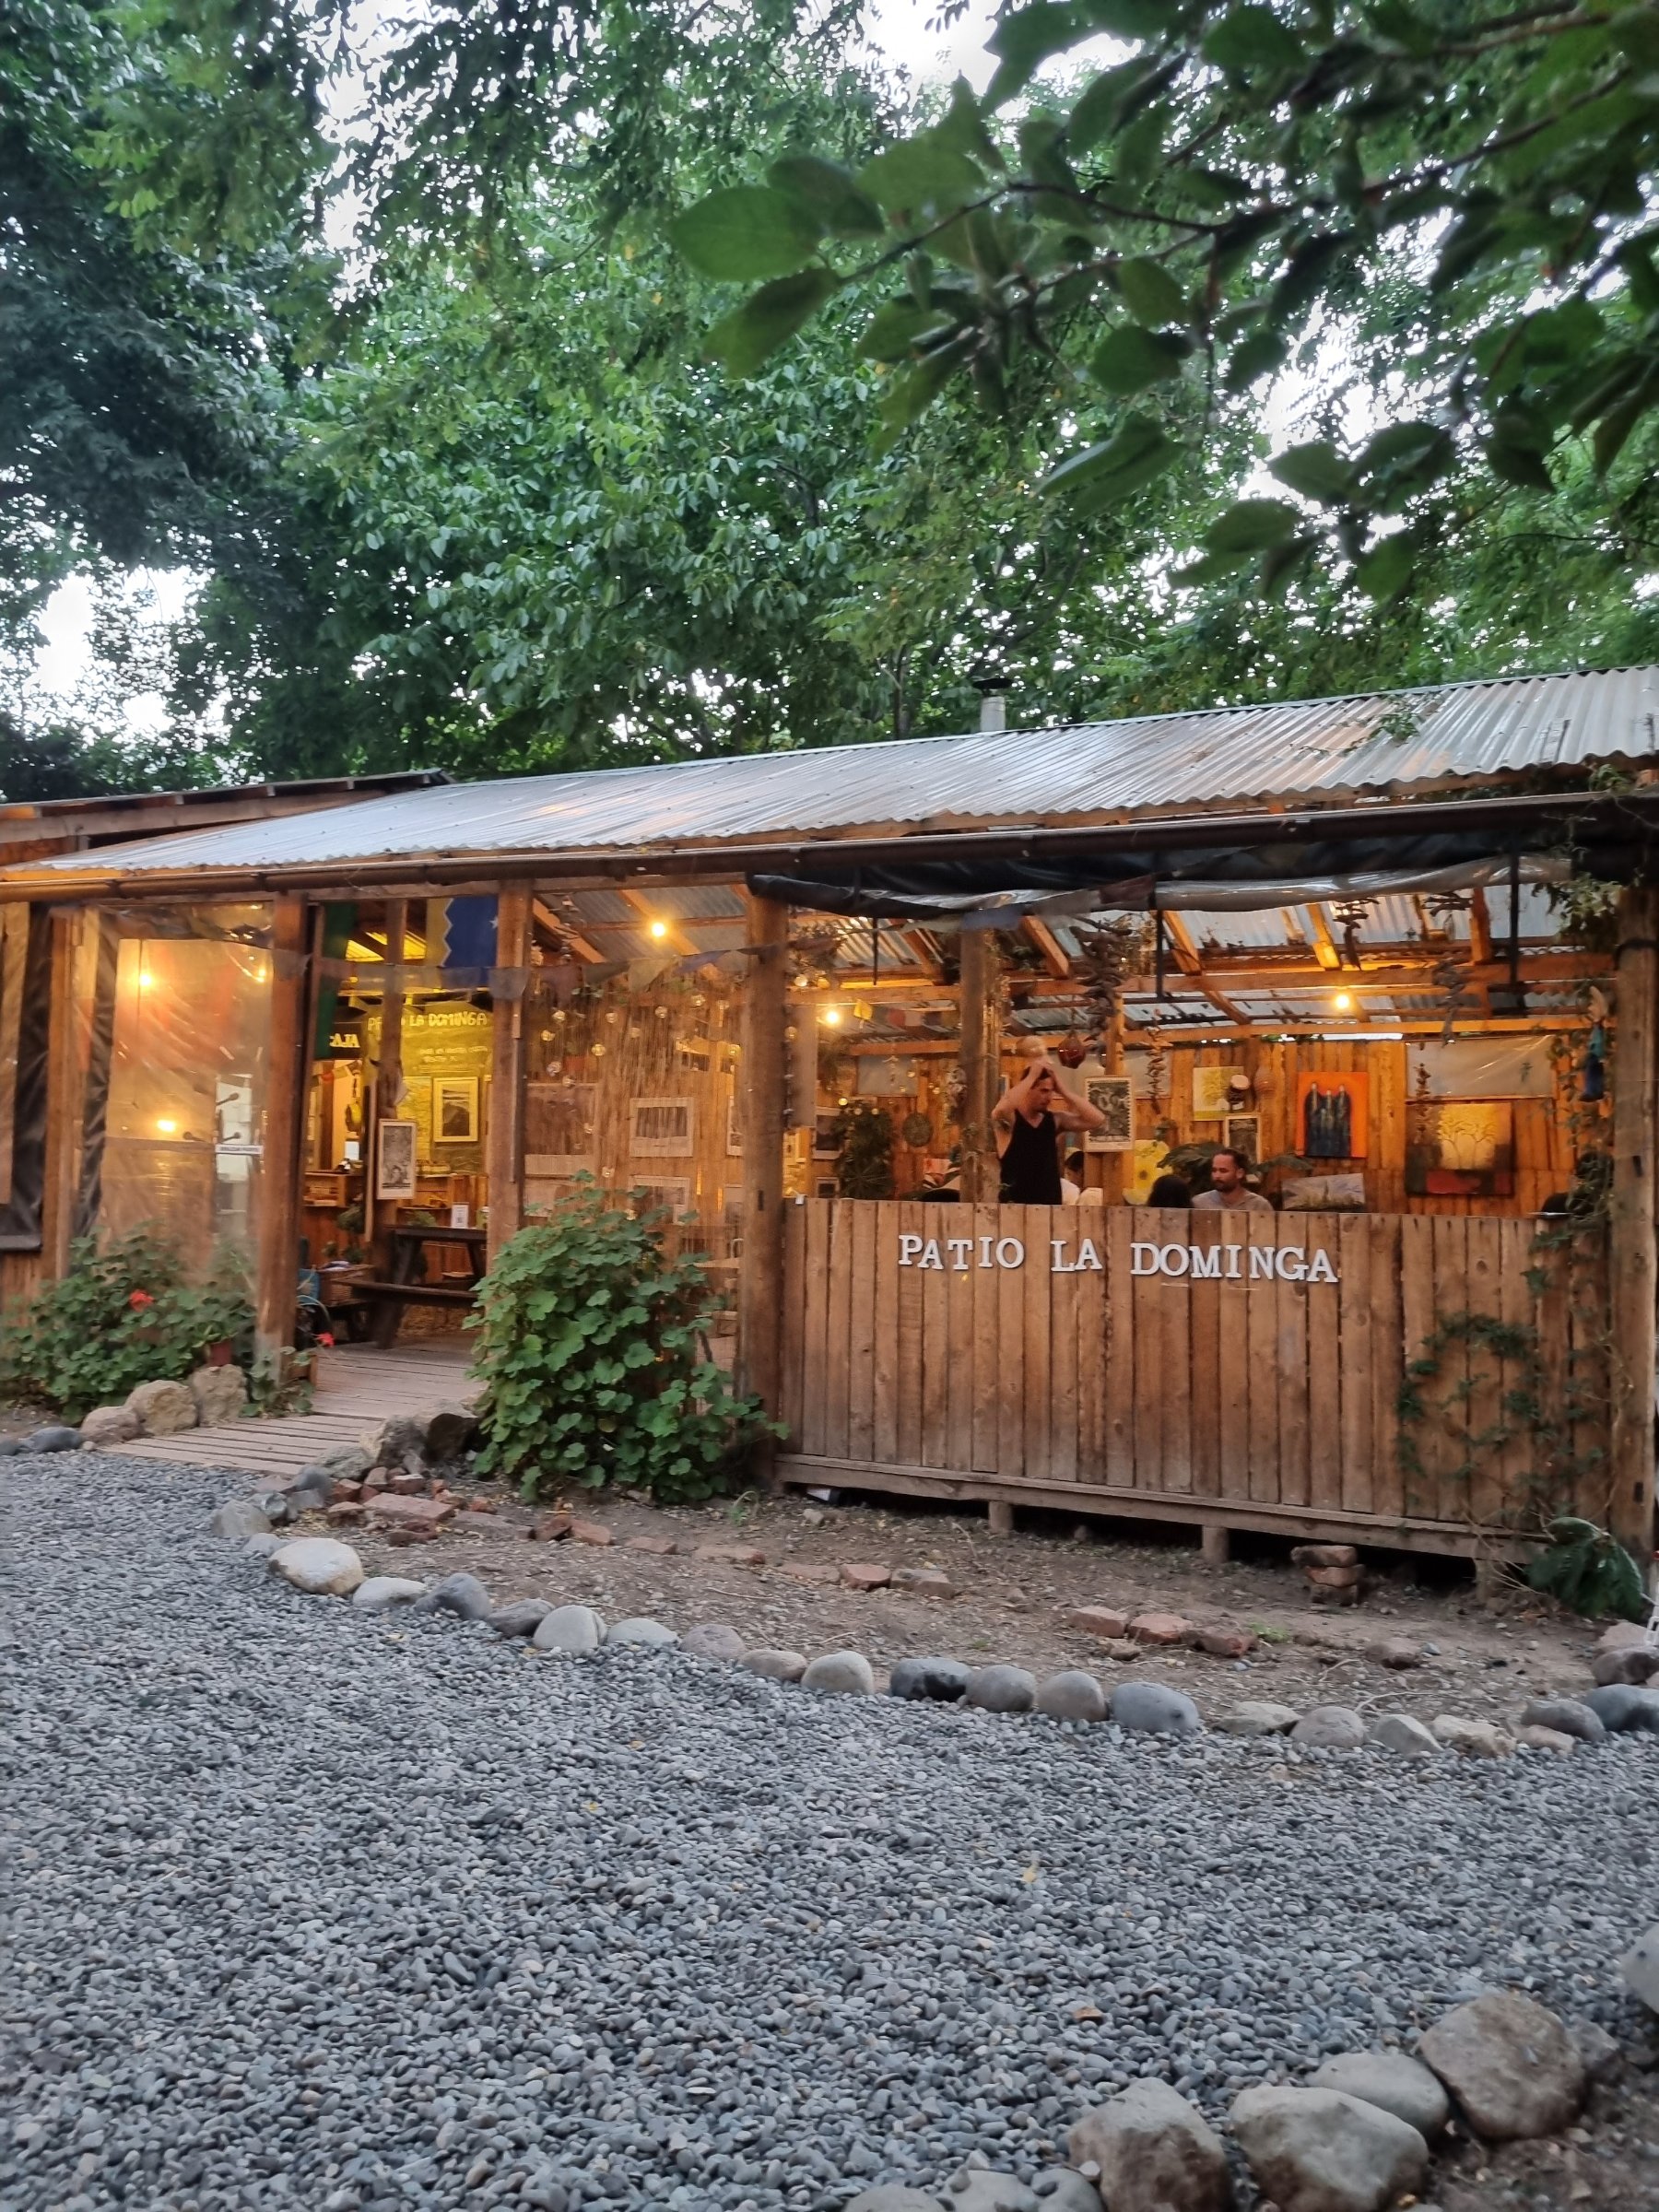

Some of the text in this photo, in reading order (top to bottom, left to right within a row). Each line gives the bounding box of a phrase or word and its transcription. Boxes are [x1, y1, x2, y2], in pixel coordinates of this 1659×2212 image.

[409, 1015, 425, 1027] LA
[429, 1011, 488, 1027] DOMINGA
[898, 1234, 1339, 1283] PATIO LA DOMINGA
